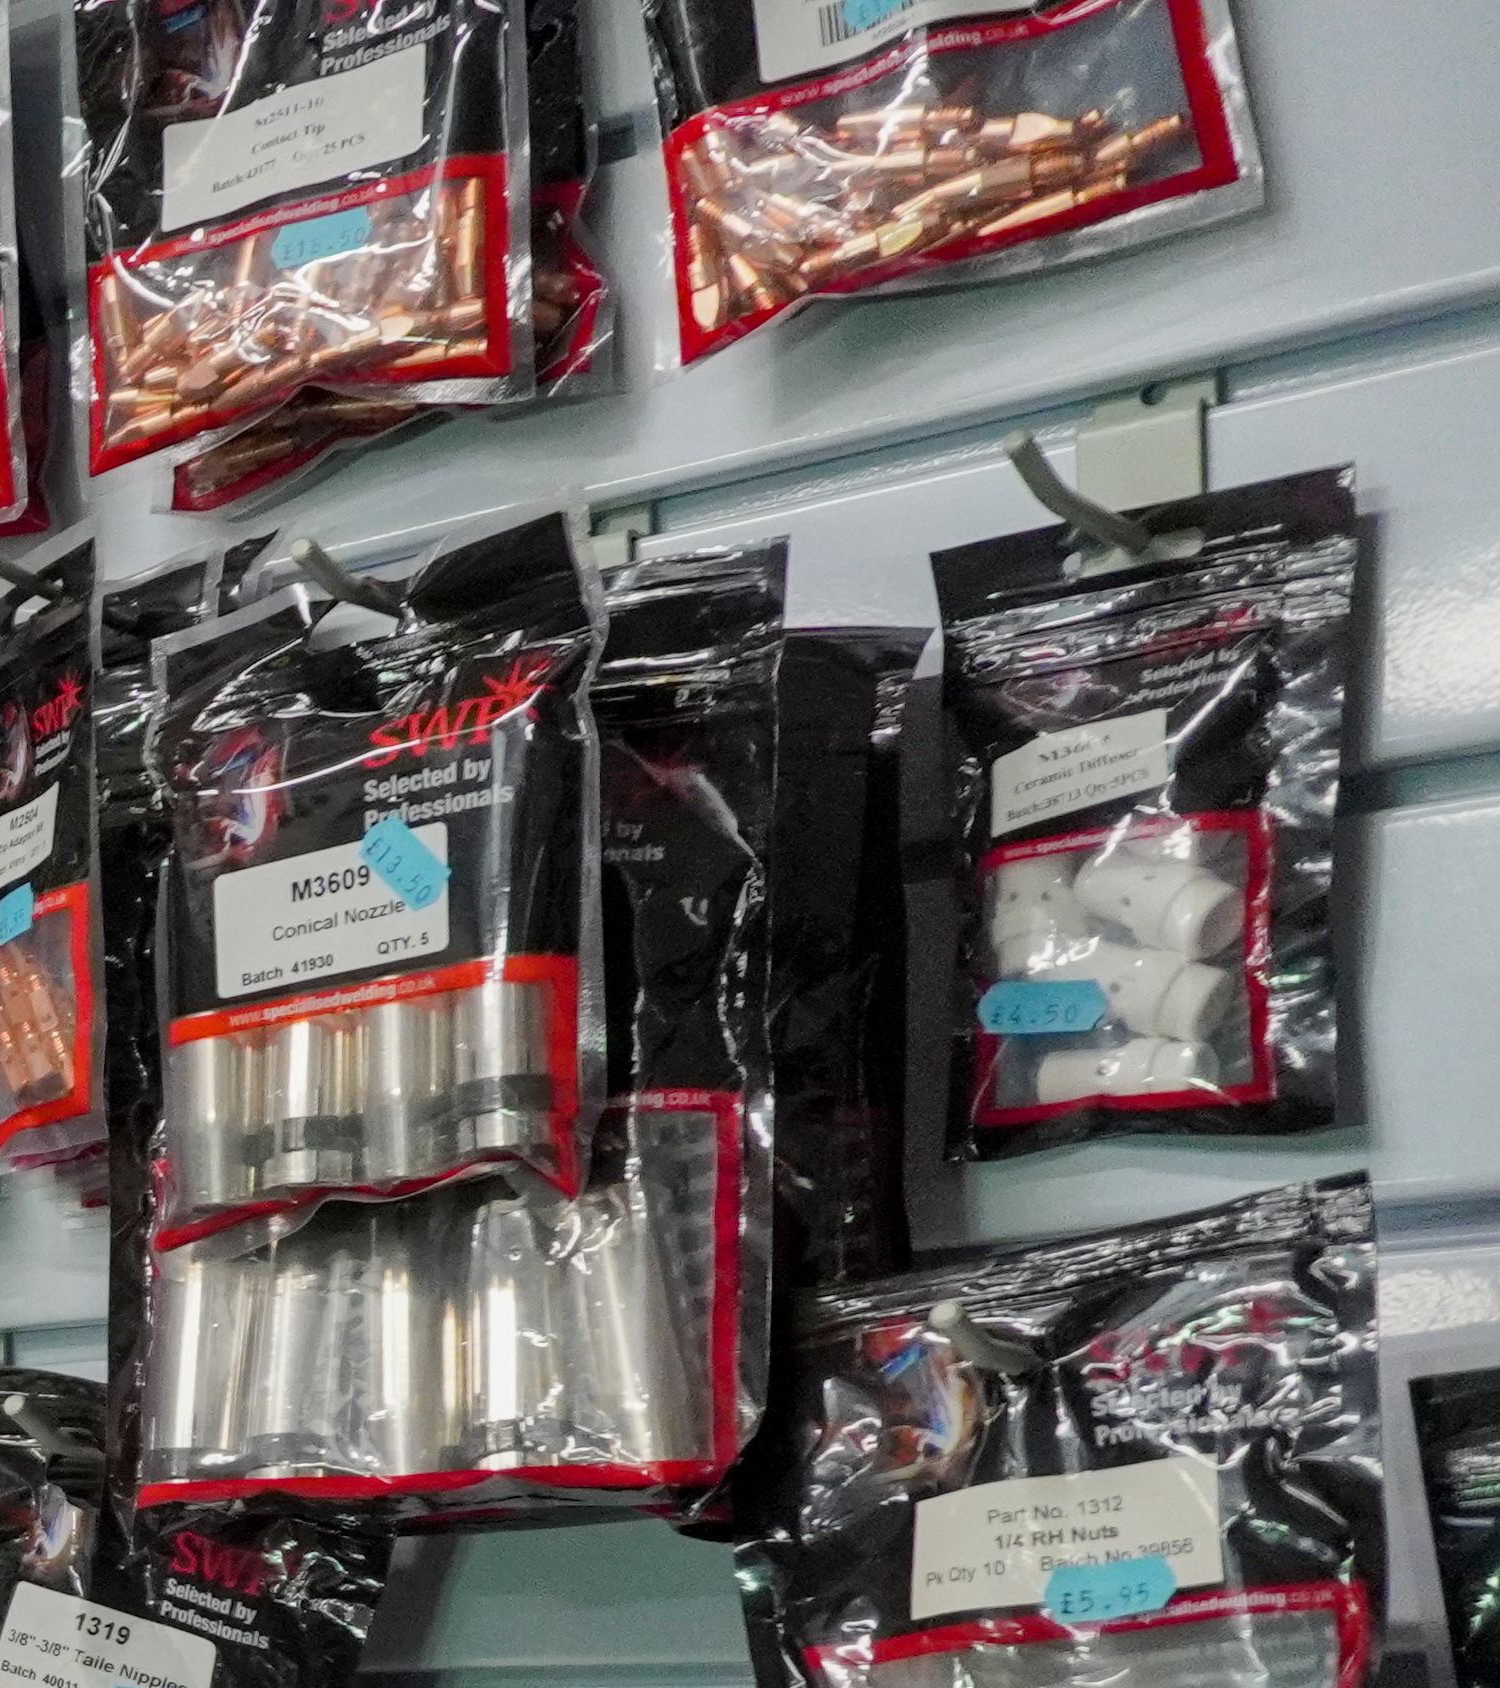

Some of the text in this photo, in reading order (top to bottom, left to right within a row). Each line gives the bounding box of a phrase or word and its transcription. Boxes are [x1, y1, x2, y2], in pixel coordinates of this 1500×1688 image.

[304, 124, 325, 137] Tip
[364, 696, 502, 769] SWP
[364, 754, 492, 802] Selected by
[292, 866, 370, 902] M3609
[273, 900, 405, 942] Conical Nozzle
[242, 932, 430, 986] Batch 41930 QTY. 5
[988, 1507, 1026, 1525] Part
[1079, 1496, 1123, 1515] 1312
[1032, 1530, 1064, 1547] RH
[1072, 1525, 1119, 1541] Nuts
[166, 1577, 257, 1625] Selected by
[1061, 1583, 1150, 1616] £5.95
[74, 1613, 131, 1645] 1319
[161, 1601, 270, 1650] Professionals
[1, 1660, 36, 1681] Batch
